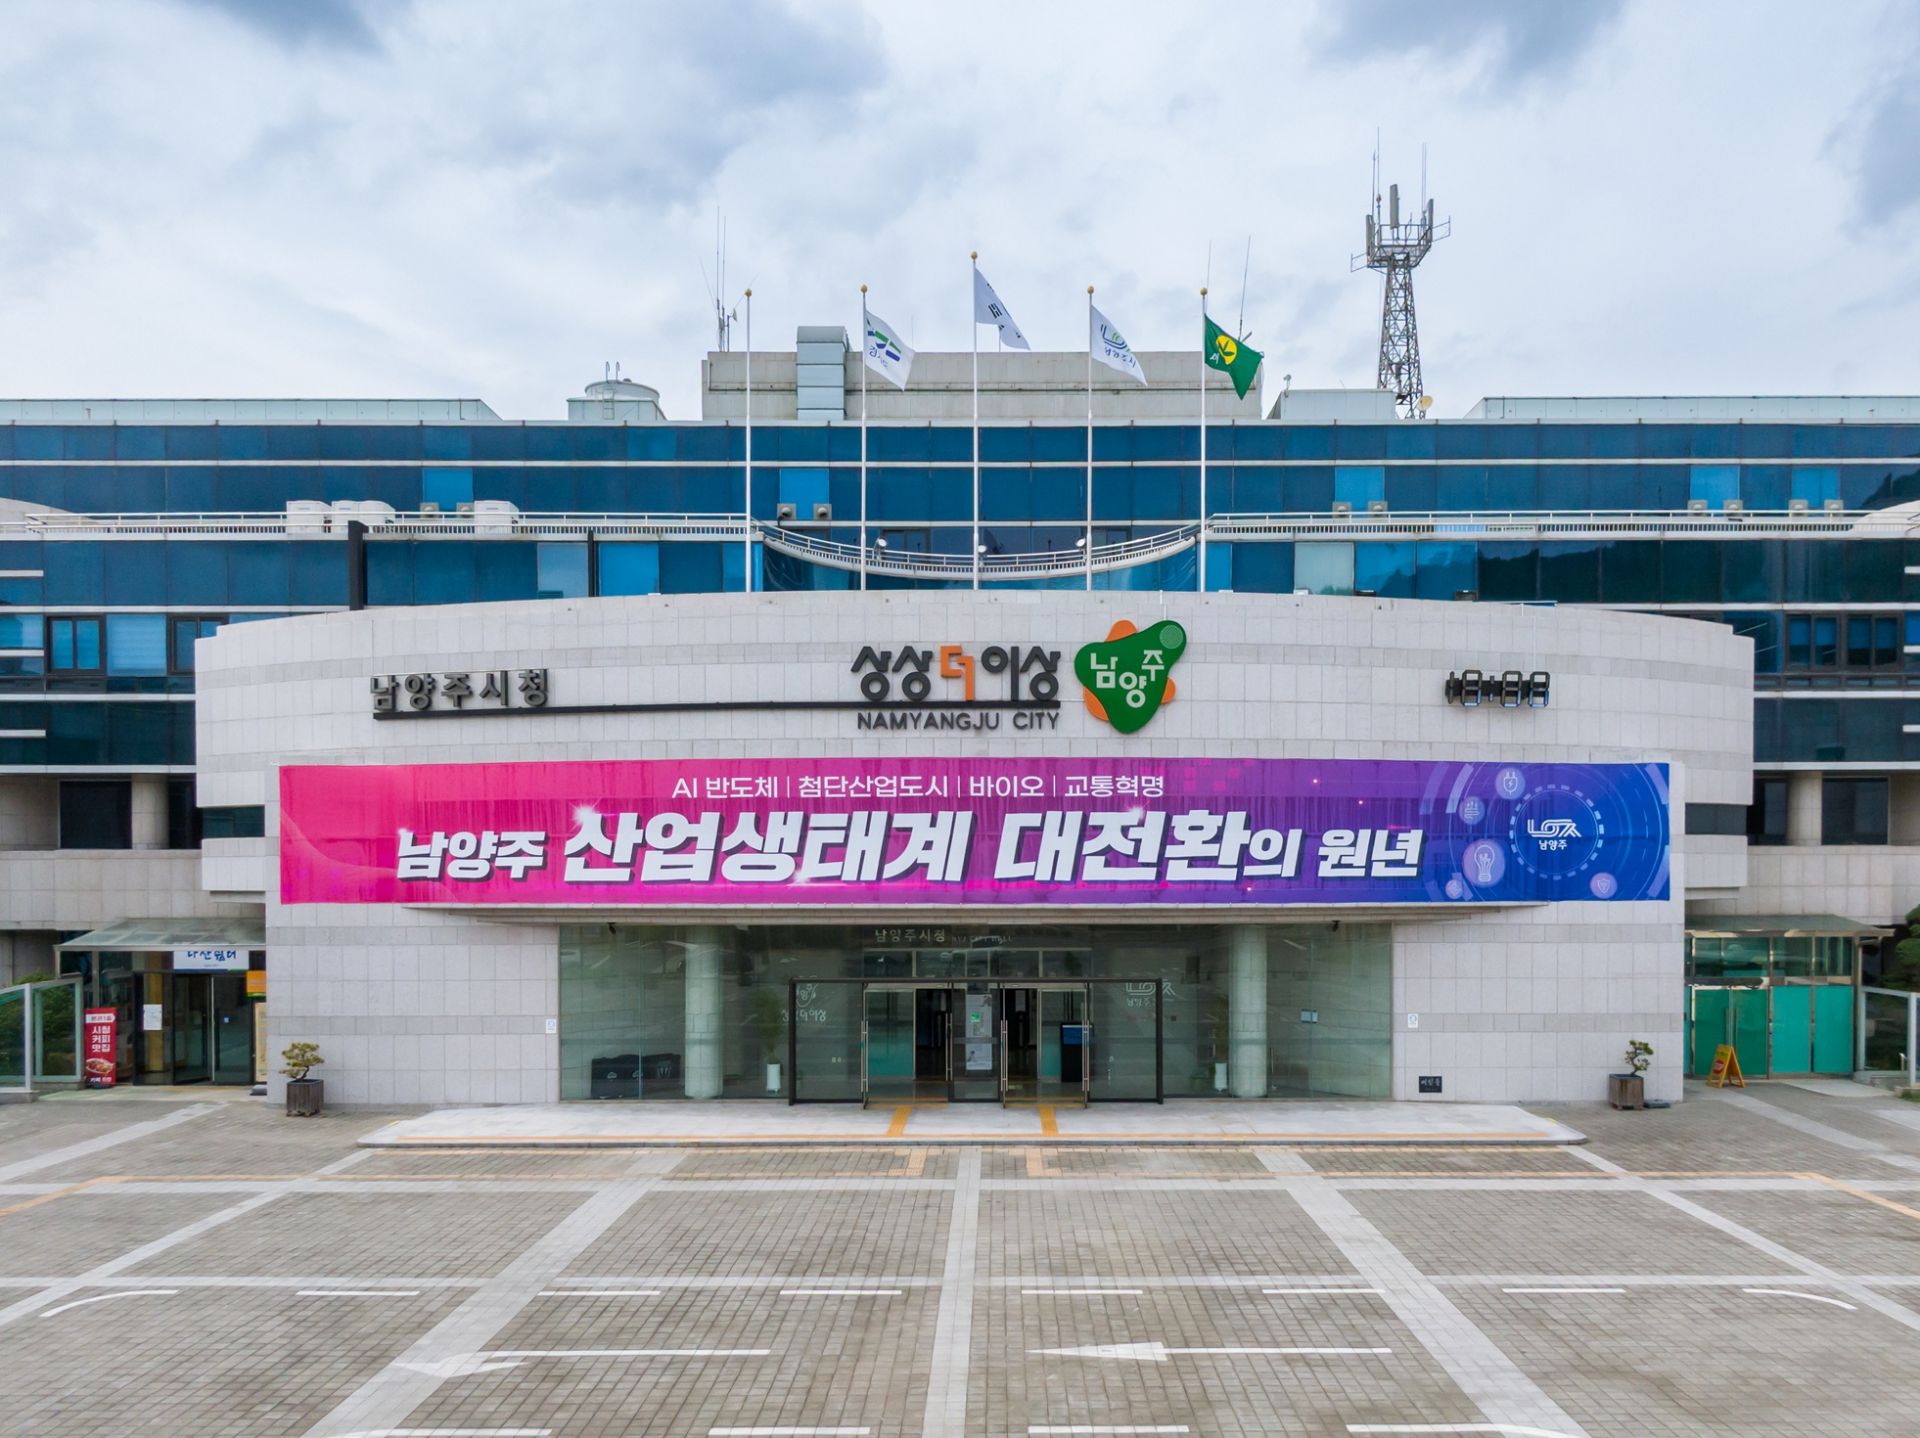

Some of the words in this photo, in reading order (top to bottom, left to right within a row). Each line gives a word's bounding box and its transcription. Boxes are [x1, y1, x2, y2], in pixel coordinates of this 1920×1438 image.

[370, 668, 549, 712] 남양주시청
[850, 644, 1061, 702] 상상더이상
[1090, 649, 1165, 708] 남양주
[857, 711, 1000, 731] NAMYANGJU
[1012, 711, 1060, 730] CITY
[671, 777, 698, 799] AI
[705, 775, 779, 799] 반도체
[798, 775, 948, 798] 첨단산업도시
[969, 775, 1045, 798] 바이오
[1064, 775, 1165, 798] 교통혁명
[397, 830, 549, 882] 남양주
[563, 810, 978, 884] 산업생태계
[993, 810, 1304, 883] 대전환의
[1317, 828, 1425, 880] 원년
[1538, 839, 1568, 851] 남양주
